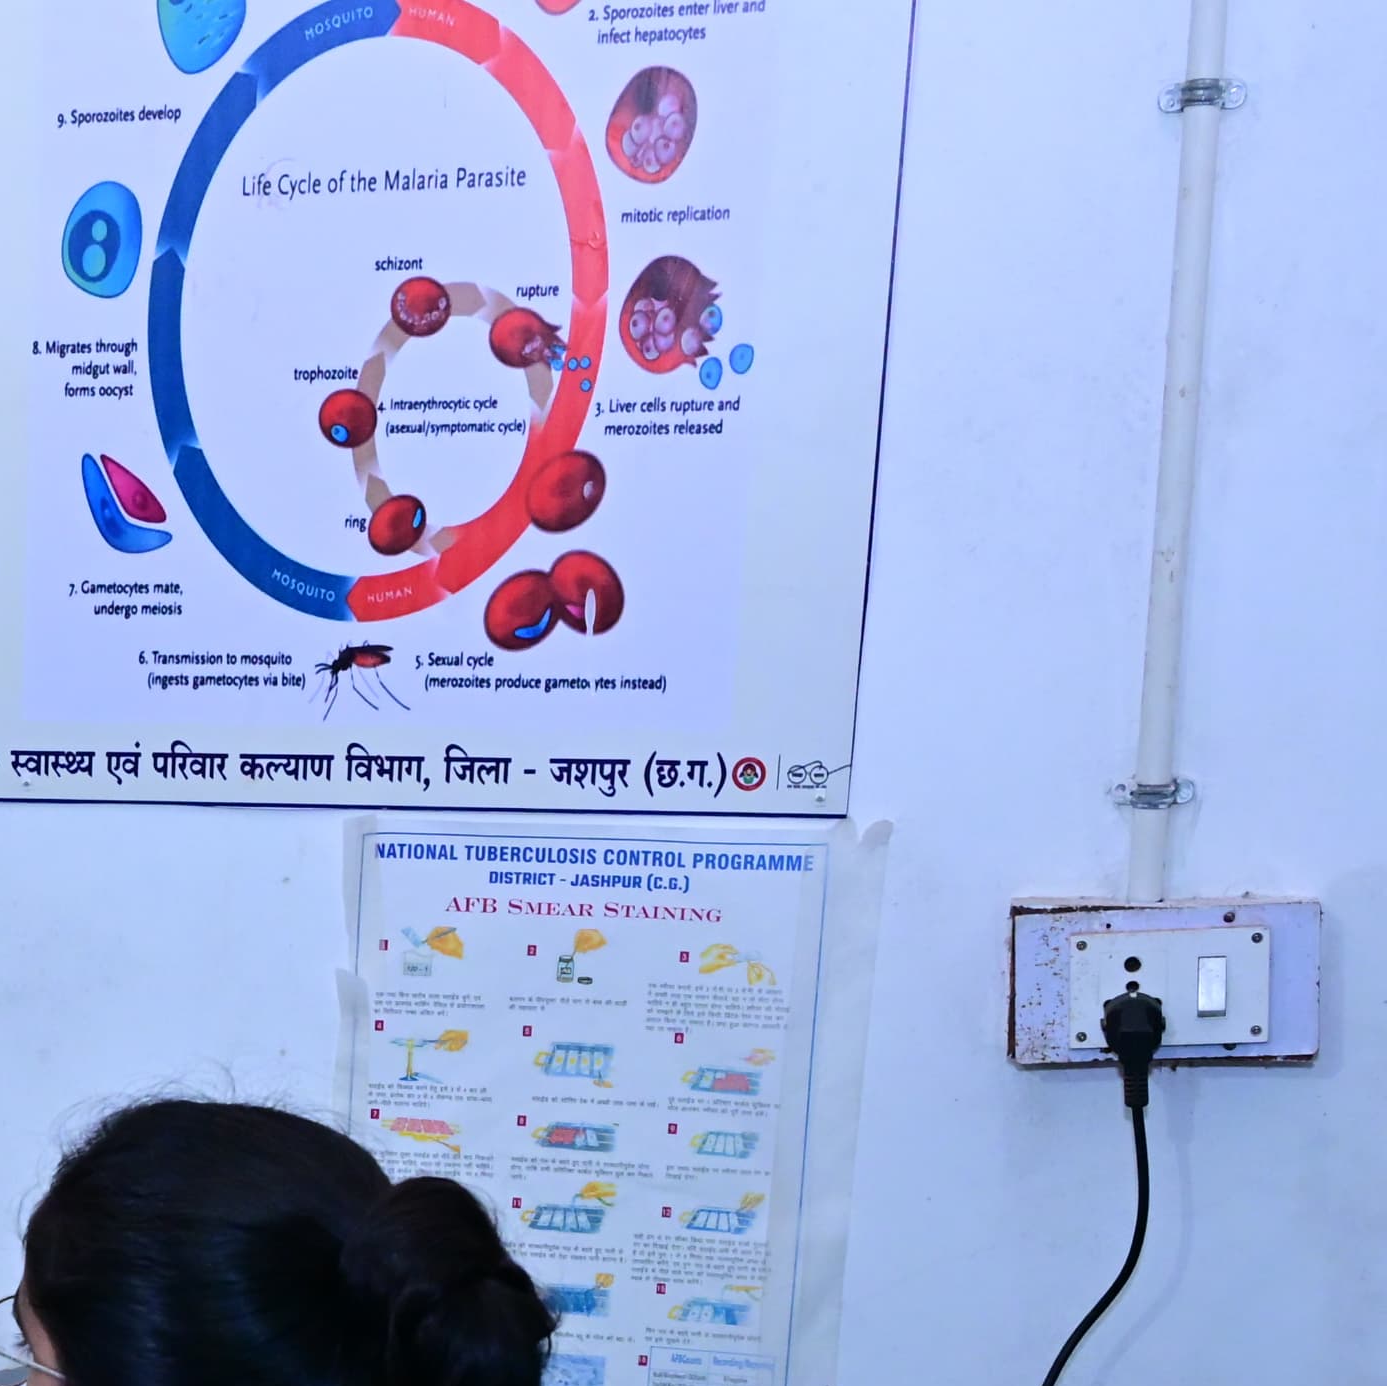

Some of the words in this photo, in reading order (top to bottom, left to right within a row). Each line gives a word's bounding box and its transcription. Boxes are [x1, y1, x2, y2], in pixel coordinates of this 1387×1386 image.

[409, 7, 455, 27] HUMAN
[589, 9, 598, 21] 2.
[603, 5, 674, 24] Sporozoites
[678, 3, 709, 16] enter
[714, 0, 739, 14] liver
[743, 0, 765, 12] and
[305, 6, 374, 41] MOSQUITO
[598, 27, 630, 44] infect
[635, 26, 706, 45] hepatocytes
[58, 114, 67, 128] 9.
[71, 110, 135, 127] Sporozoites
[139, 104, 181, 122] develop
[243, 173, 271, 196] Life
[278, 172, 321, 200] Cycle
[328, 170, 347, 193] of
[351, 171, 377, 192] the
[385, 168, 447, 190] Malaria
[457, 168, 526, 188] Parasite
[621, 208, 663, 222] mitotic
[667, 206, 730, 225] replication
[375, 256, 422, 271] schizont
[517, 285, 559, 300] rupture
[32, 341, 41, 355] 8.
[46, 341, 91, 358] Migrates
[96, 338, 137, 357] through
[72, 361, 109, 379] midgut
[113, 360, 136, 375] wall,
[294, 366, 360, 384] trophozoite
[65, 382, 95, 397] forms
[99, 384, 133, 400] oocyst
[391, 397, 470, 413] Intraerythrocytic
[474, 396, 497, 412] cycle
[595, 402, 604, 417] 3.
[609, 400, 637, 413] Liver
[640, 397, 666, 412] cells
[670, 400, 714, 415] rupture
[718, 396, 740, 411] and
[386, 420, 495, 437] (asexual/symptomatic
[498, 419, 526, 435] cycle)
[605, 423, 669, 435] merozoites
[674, 419, 723, 434] released
[344, 514, 366, 533] ring
[81, 580, 149, 597] Gametocytes
[154, 582, 182, 595] mate,
[271, 568, 336, 603] MOSQUITO
[366, 586, 413, 604] HUMAN
[94, 601, 137, 619] undergo
[141, 603, 182, 615] meiosis
[152, 651, 222, 665] Transmission
[227, 653, 237, 665] to
[241, 654, 292, 668] mosquito
[428, 652, 463, 666] Sexual
[467, 652, 494, 670] cycle
[148, 673, 189, 690] (ingests
[193, 675, 259, 690] gametocytes
[263, 676, 278, 686] via
[282, 672, 305, 690] bite)
[425, 675, 491, 691] (merozoites
[495, 674, 541, 691] produce
[621, 676, 666, 693] instead)
[11, 750, 95, 777] स्वास्थ्य
[106, 742, 141, 785] एवं
[152, 740, 228, 780] परिवार
[240, 754, 334, 781] कल्याण
[345, 743, 430, 791] विभाग,
[444, 744, 512, 785] जिला
[550, 759, 631, 797] जशपुर
[644, 751, 726, 798] (छ.ग.)
[376, 843, 458, 860] NATIONAL
[465, 845, 596, 864] TUBERCULOSIS
[604, 849, 685, 868] CONTROL
[693, 853, 813, 871] PROGRAMME
[489, 871, 556, 885] DISTRICT
[571, 874, 642, 888] JASHPUR
[647, 874, 689, 893] (C.G.)
[446, 897, 497, 913] AFB
[508, 900, 593, 916] SMEAR
[604, 903, 720, 922] STAINING
